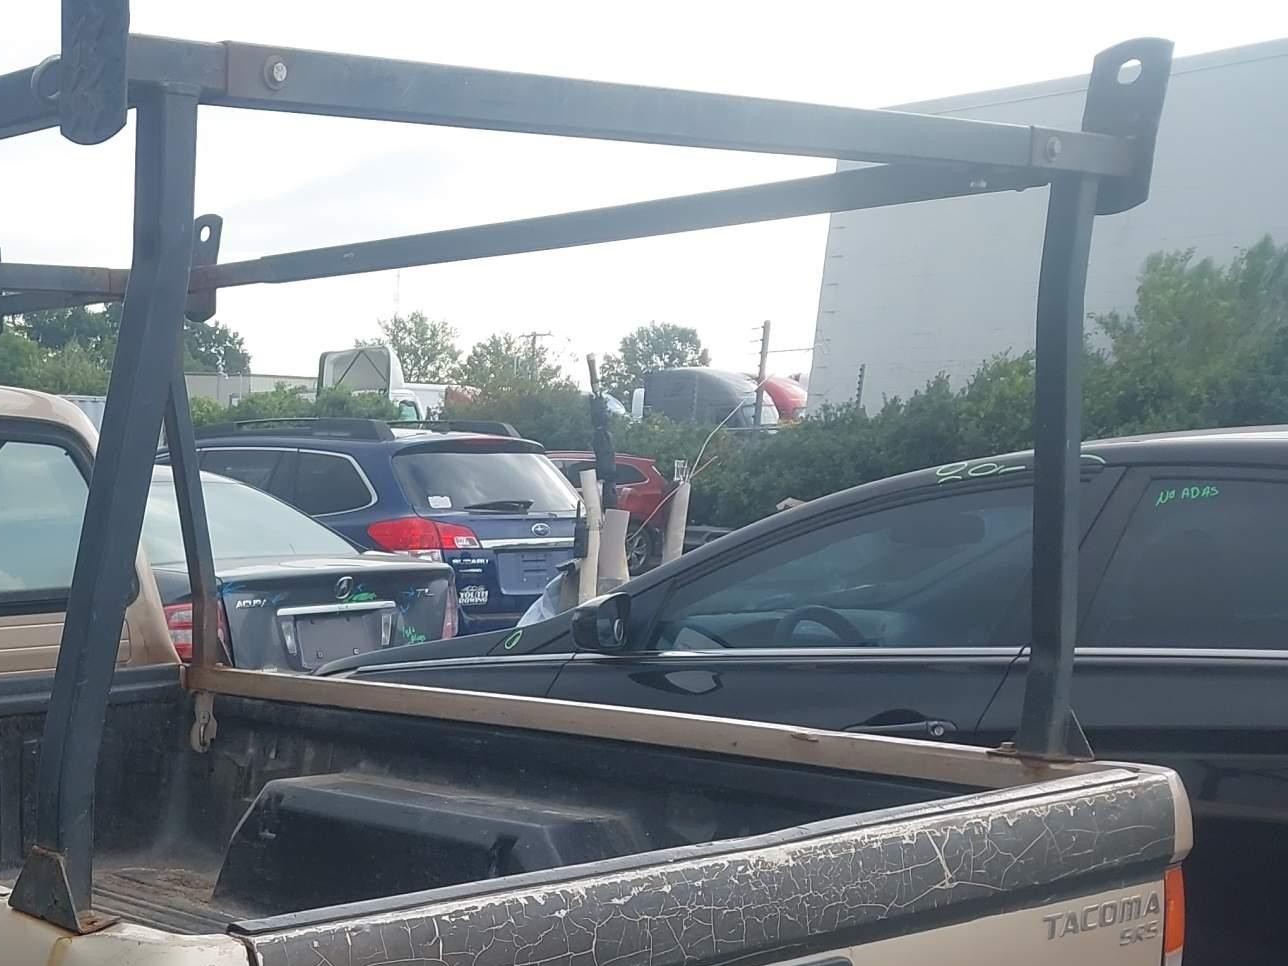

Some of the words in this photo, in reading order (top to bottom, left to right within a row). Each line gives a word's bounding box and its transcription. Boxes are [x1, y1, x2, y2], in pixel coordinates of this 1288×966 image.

[1181, 486, 1220, 500] ADAS
[1042, 890, 1160, 941] TACOMA
[1119, 920, 1160, 947] SR5
